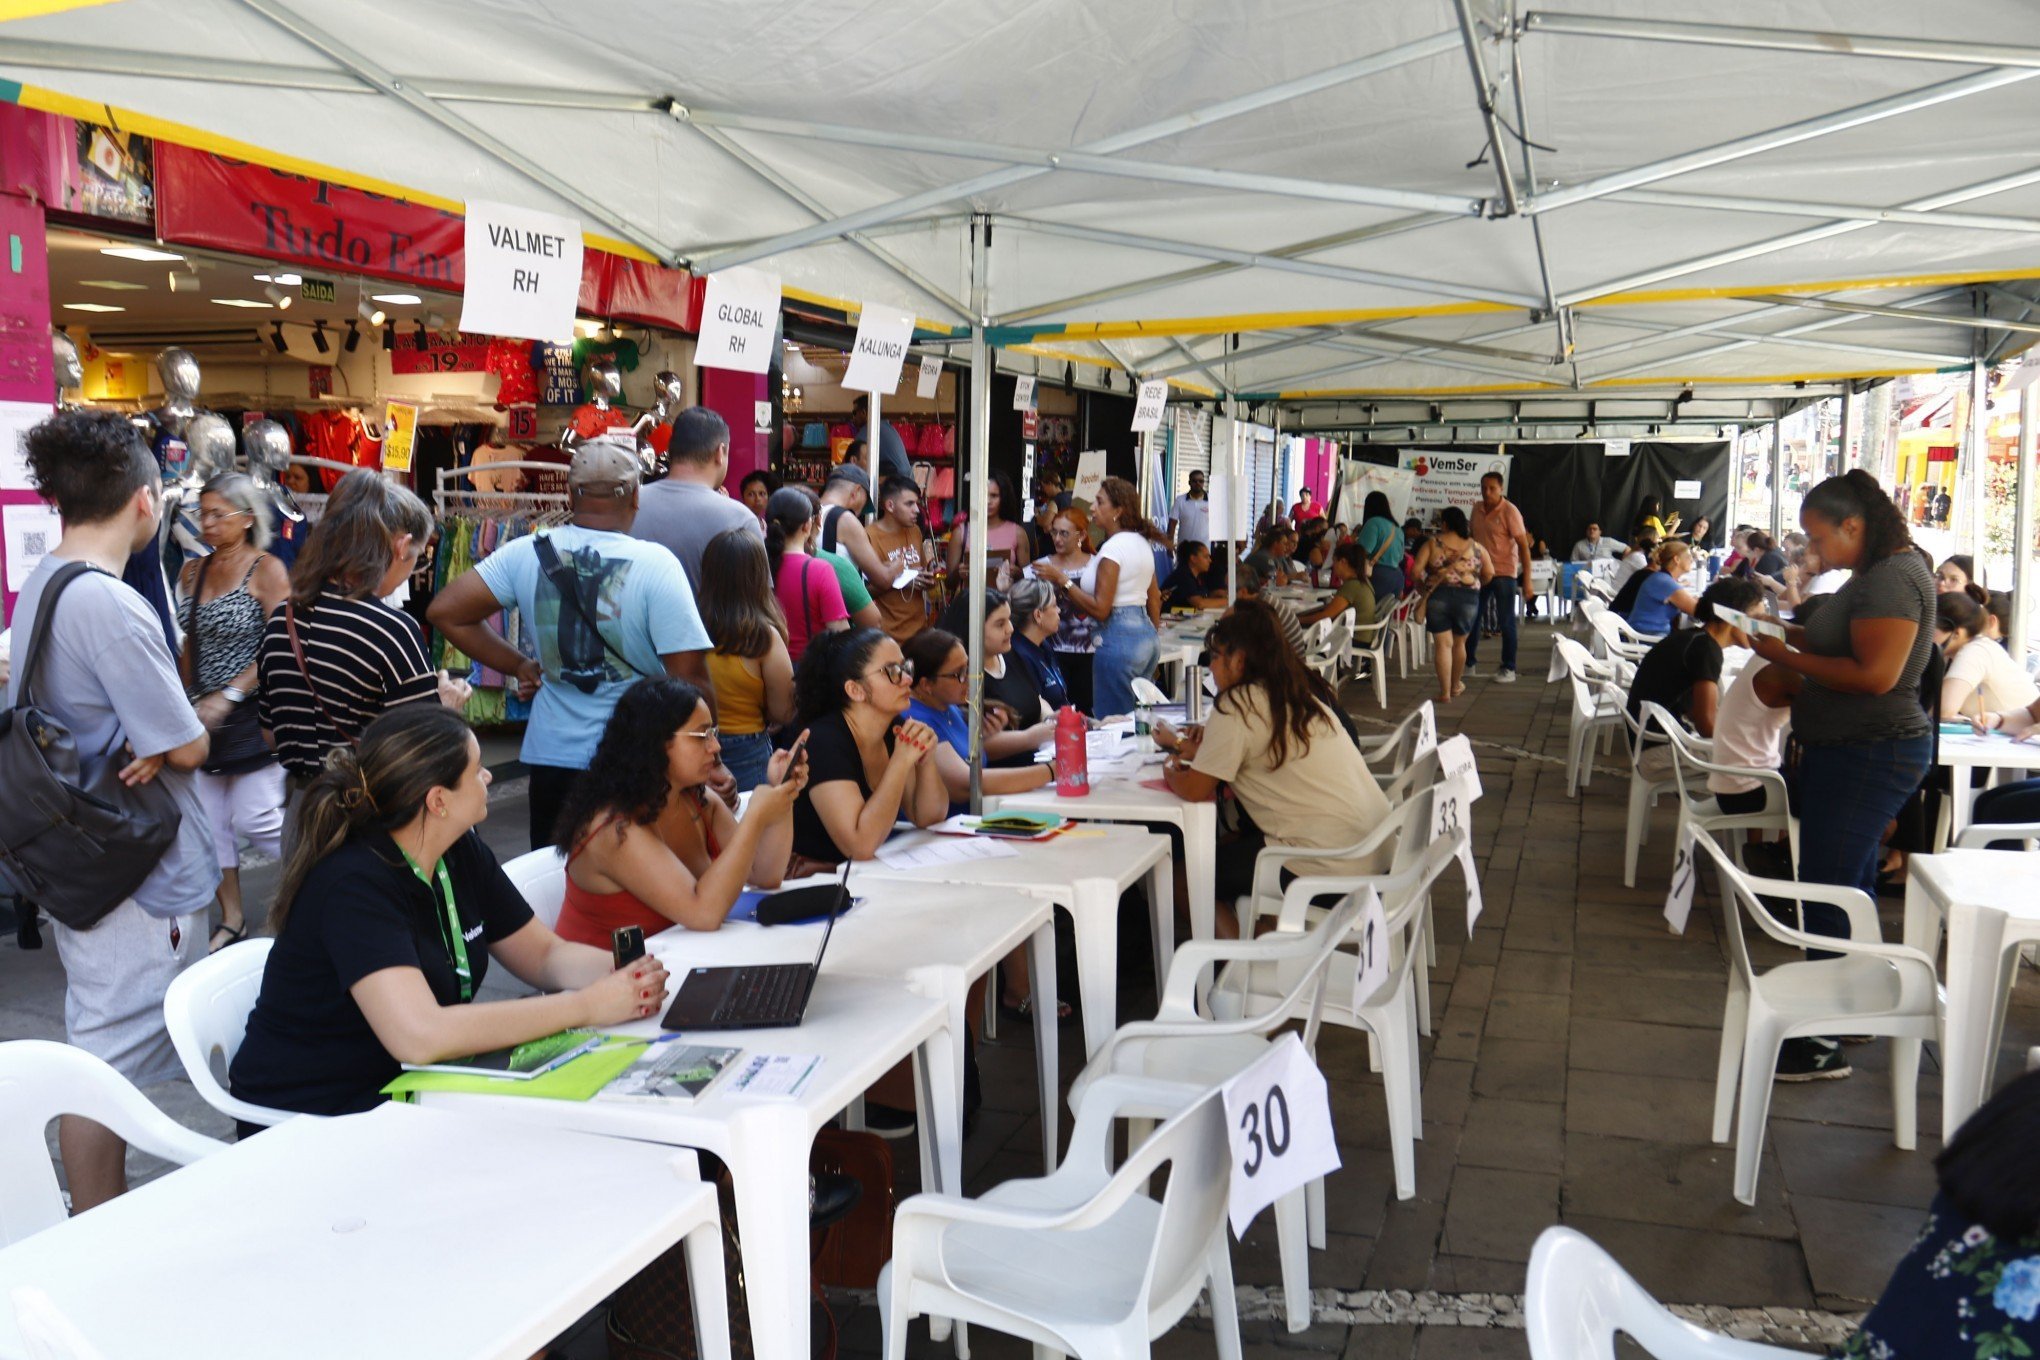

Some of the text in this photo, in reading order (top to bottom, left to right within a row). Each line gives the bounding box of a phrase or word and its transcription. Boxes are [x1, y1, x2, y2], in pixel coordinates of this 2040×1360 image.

[252, 202, 455, 284] Tudo Em
[488, 223, 565, 259] VALMET
[302, 280, 334, 301] SAÍDA
[513, 269, 539, 294] RH
[718, 304, 764, 328] GLOBAL
[729, 335, 746, 354] RH
[858, 337, 902, 359] KALUNGA
[430, 351, 459, 373] 19
[922, 363, 938, 376] PEDRA
[558, 377, 579, 389] MOS
[1144, 386, 1163, 399] REDE
[547, 388, 575, 404] OF IT
[514, 410, 531, 435] 15
[1137, 407, 1160, 419] BRASIL
[1430, 457, 1478, 471] VemSer
[1447, 497, 1476, 506] VemS
[1438, 797, 1458, 836] 33
[1241, 1084, 1291, 1178] 30
